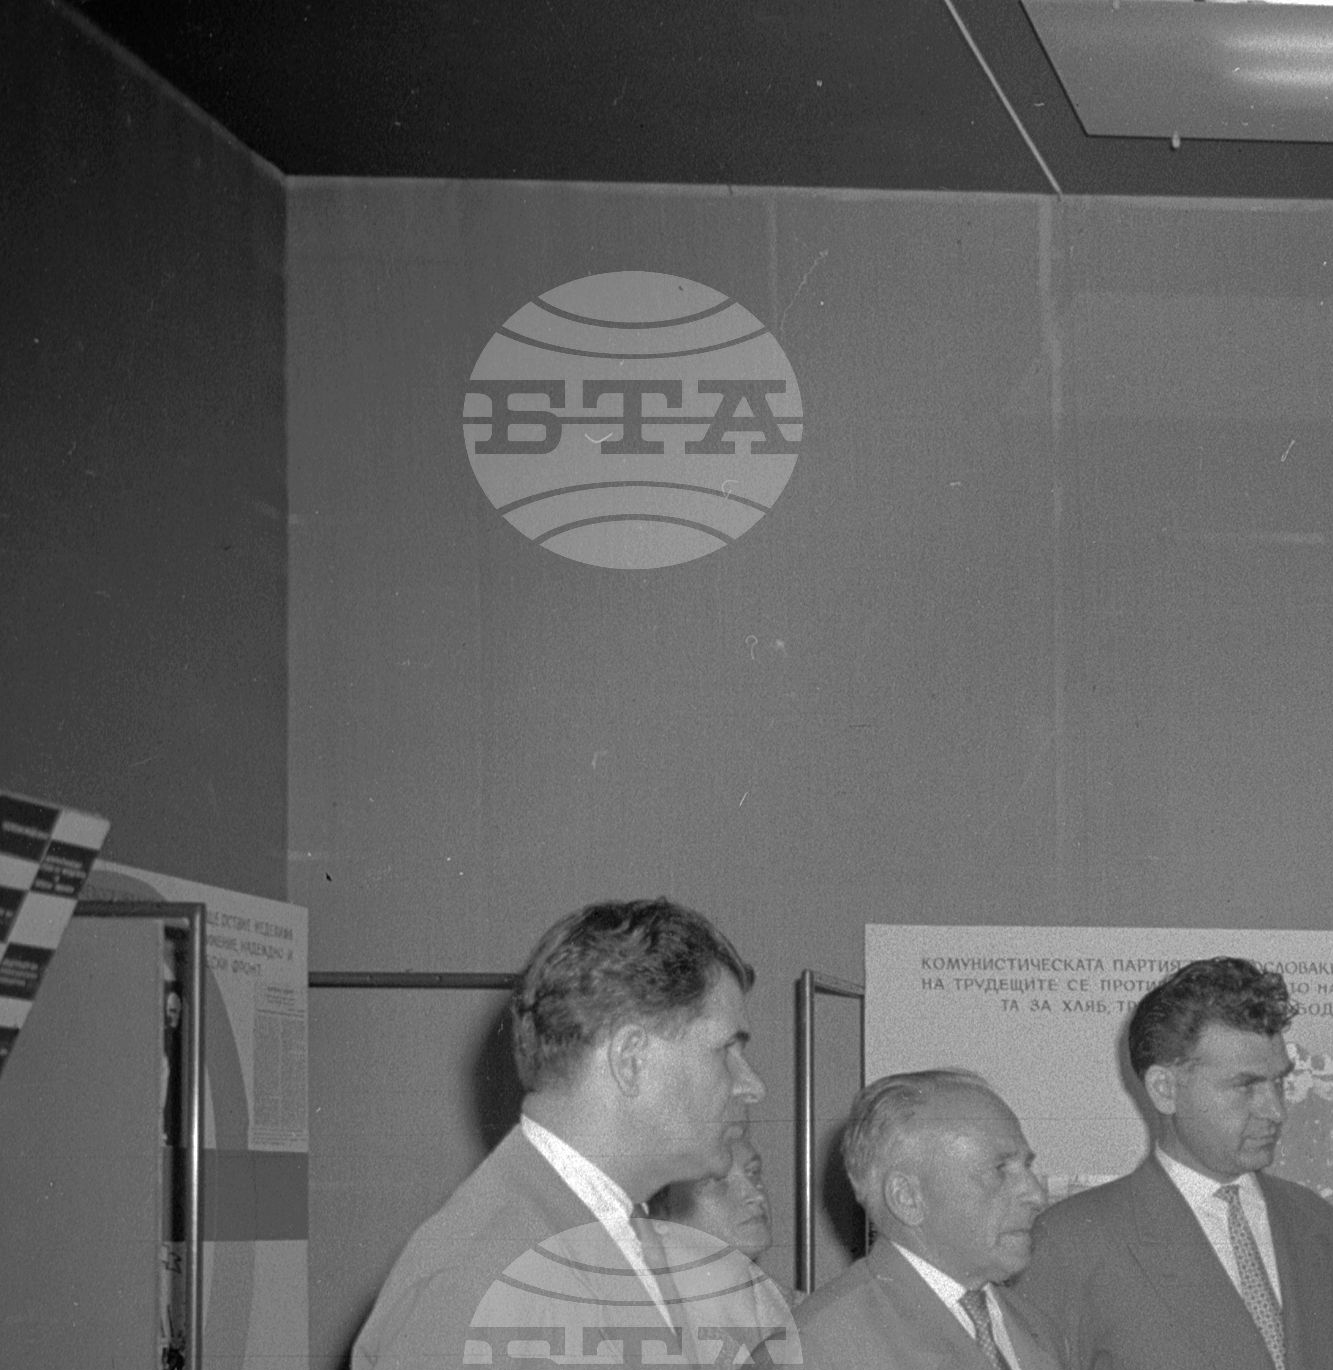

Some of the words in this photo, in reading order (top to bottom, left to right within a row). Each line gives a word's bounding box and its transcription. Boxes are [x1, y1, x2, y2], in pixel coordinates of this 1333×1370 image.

[921, 956, 1104, 972] КОМУНИСТИЧЕСКАТА
[1112, 957, 1181, 973] ПАРТИЯ
[921, 977, 945, 991] НА
[954, 978, 1058, 994] ТРУДЕЩИТЕ
[1066, 979, 1089, 992] СЕ
[1100, 979, 1163, 993] ПРОТИ
[1000, 999, 1020, 1012] ТА
[1030, 999, 1051, 1012] ЗА
